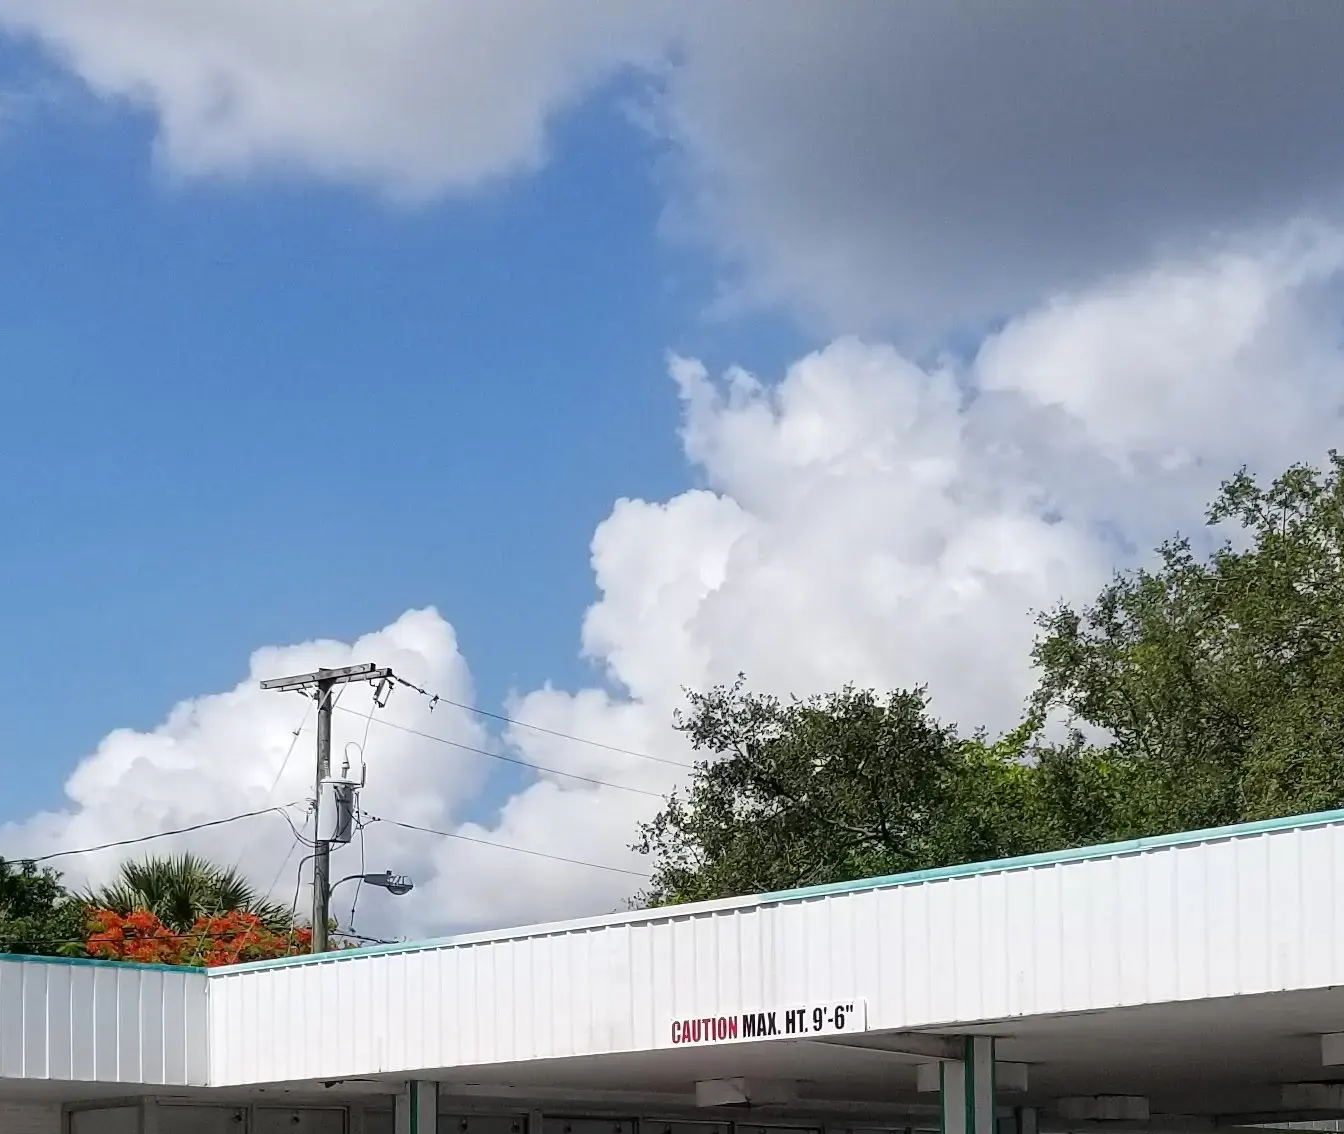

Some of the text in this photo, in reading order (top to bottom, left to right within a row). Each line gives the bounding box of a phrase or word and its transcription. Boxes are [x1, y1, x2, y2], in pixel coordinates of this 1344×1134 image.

[671, 1004, 854, 1044] CAUTION MAX. HT. 9'-6"
